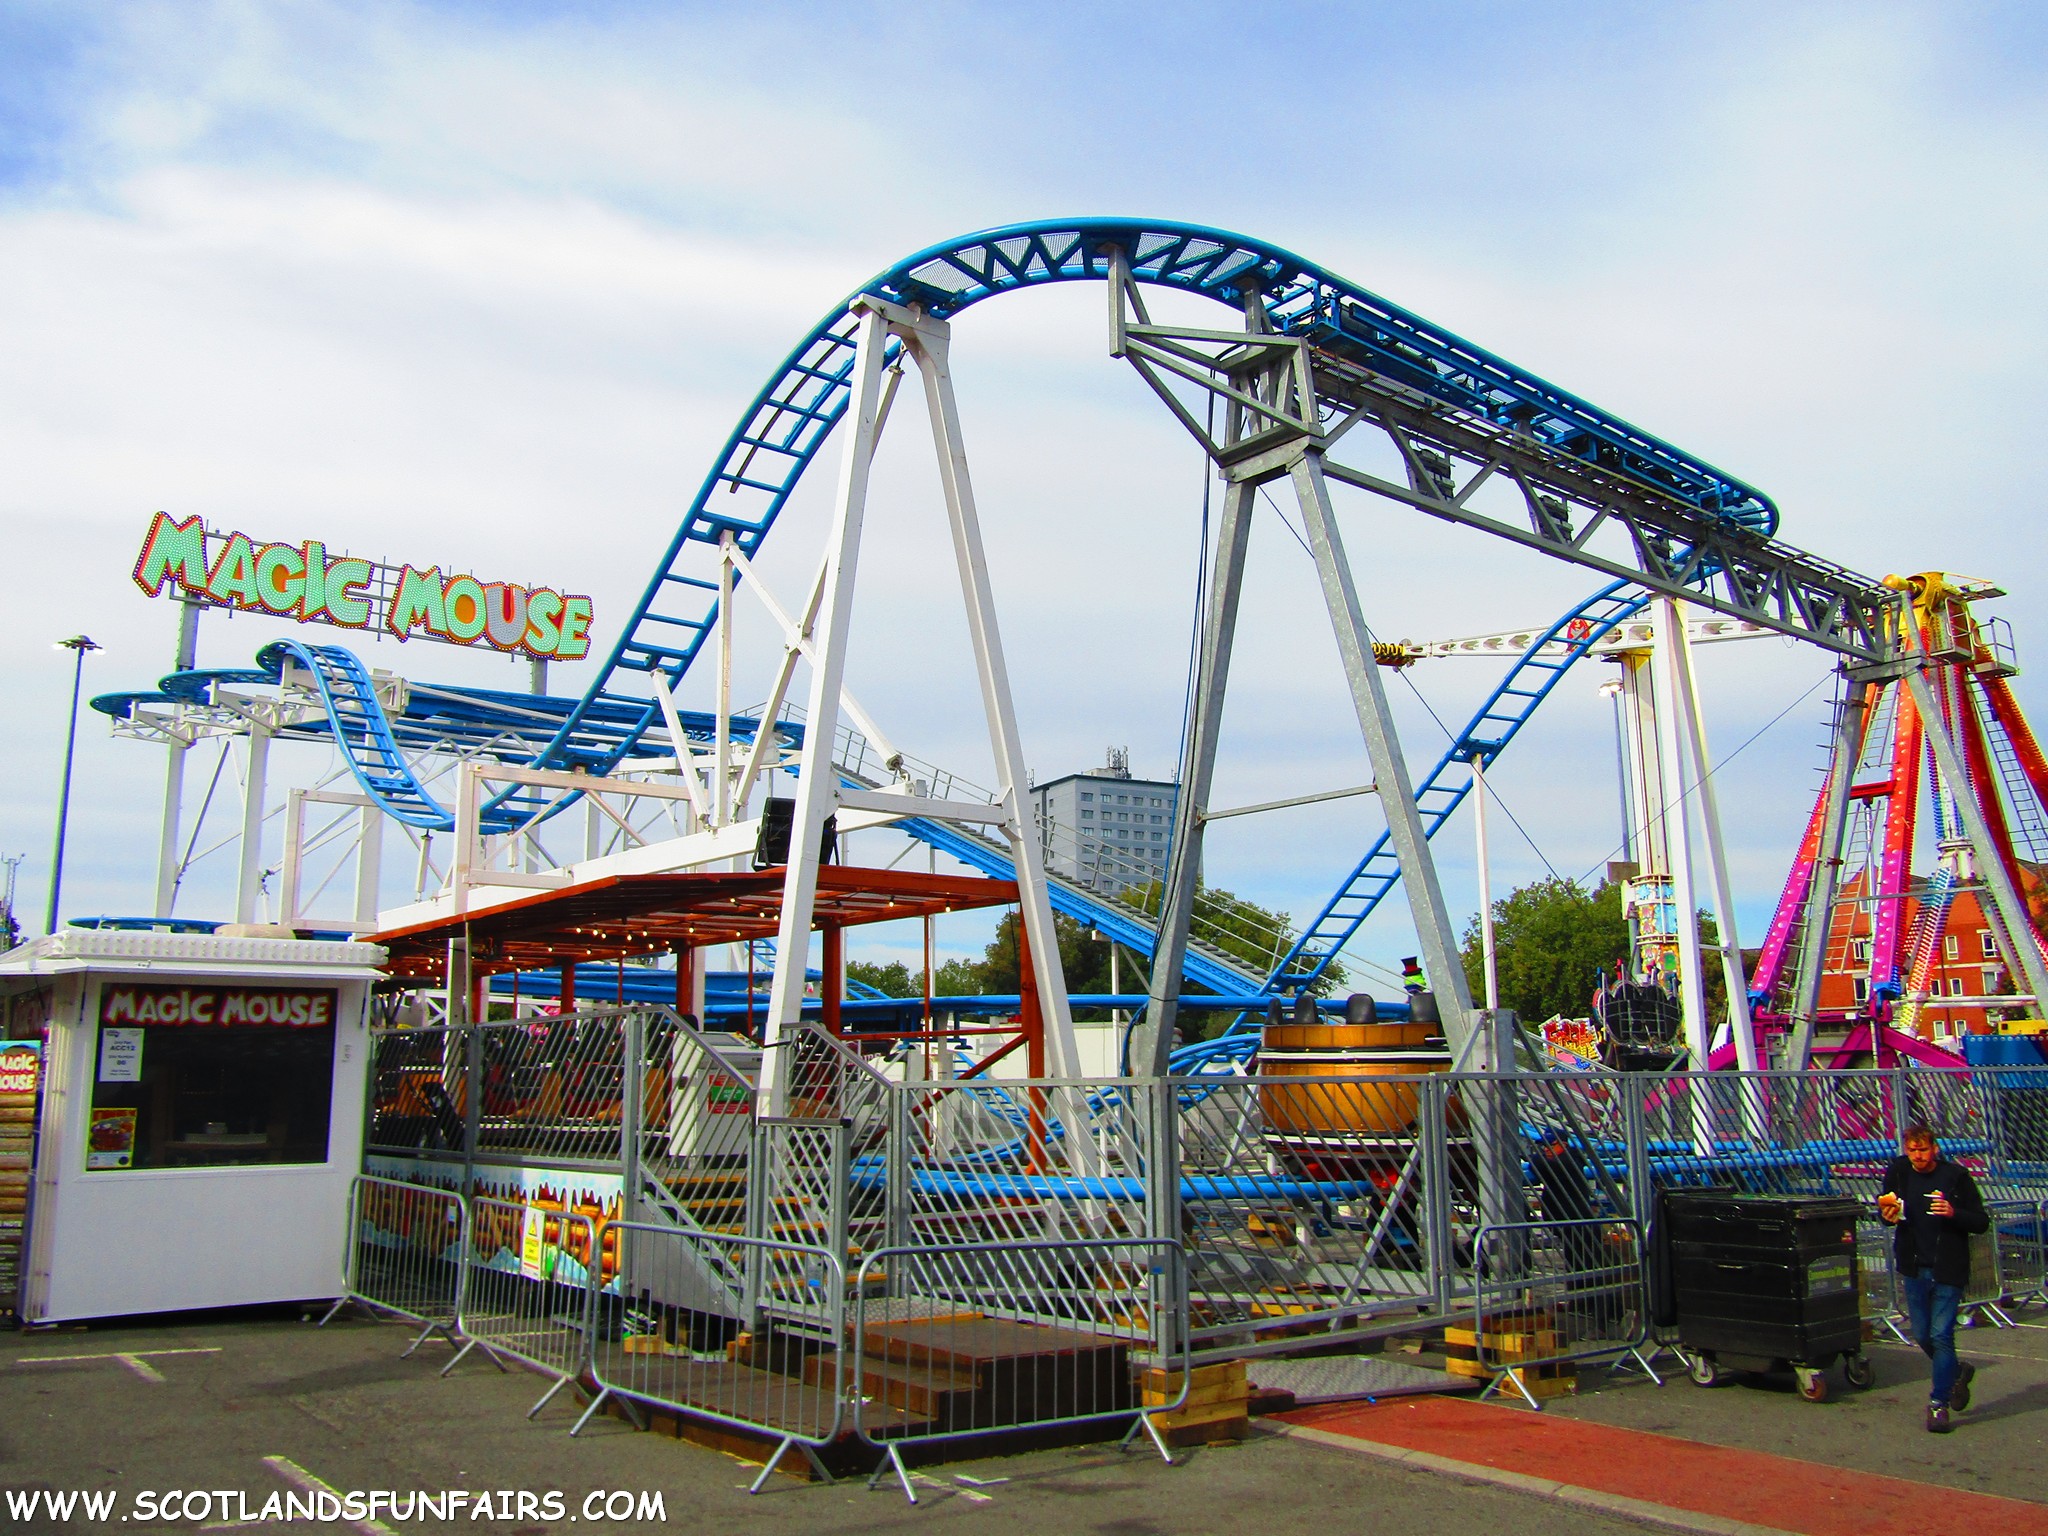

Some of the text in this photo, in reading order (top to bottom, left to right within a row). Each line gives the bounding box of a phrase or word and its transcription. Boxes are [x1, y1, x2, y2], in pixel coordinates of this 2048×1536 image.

[132, 511, 594, 661] MAGIC MOUSE
[104, 989, 331, 1028] MAGIC MOUSE
